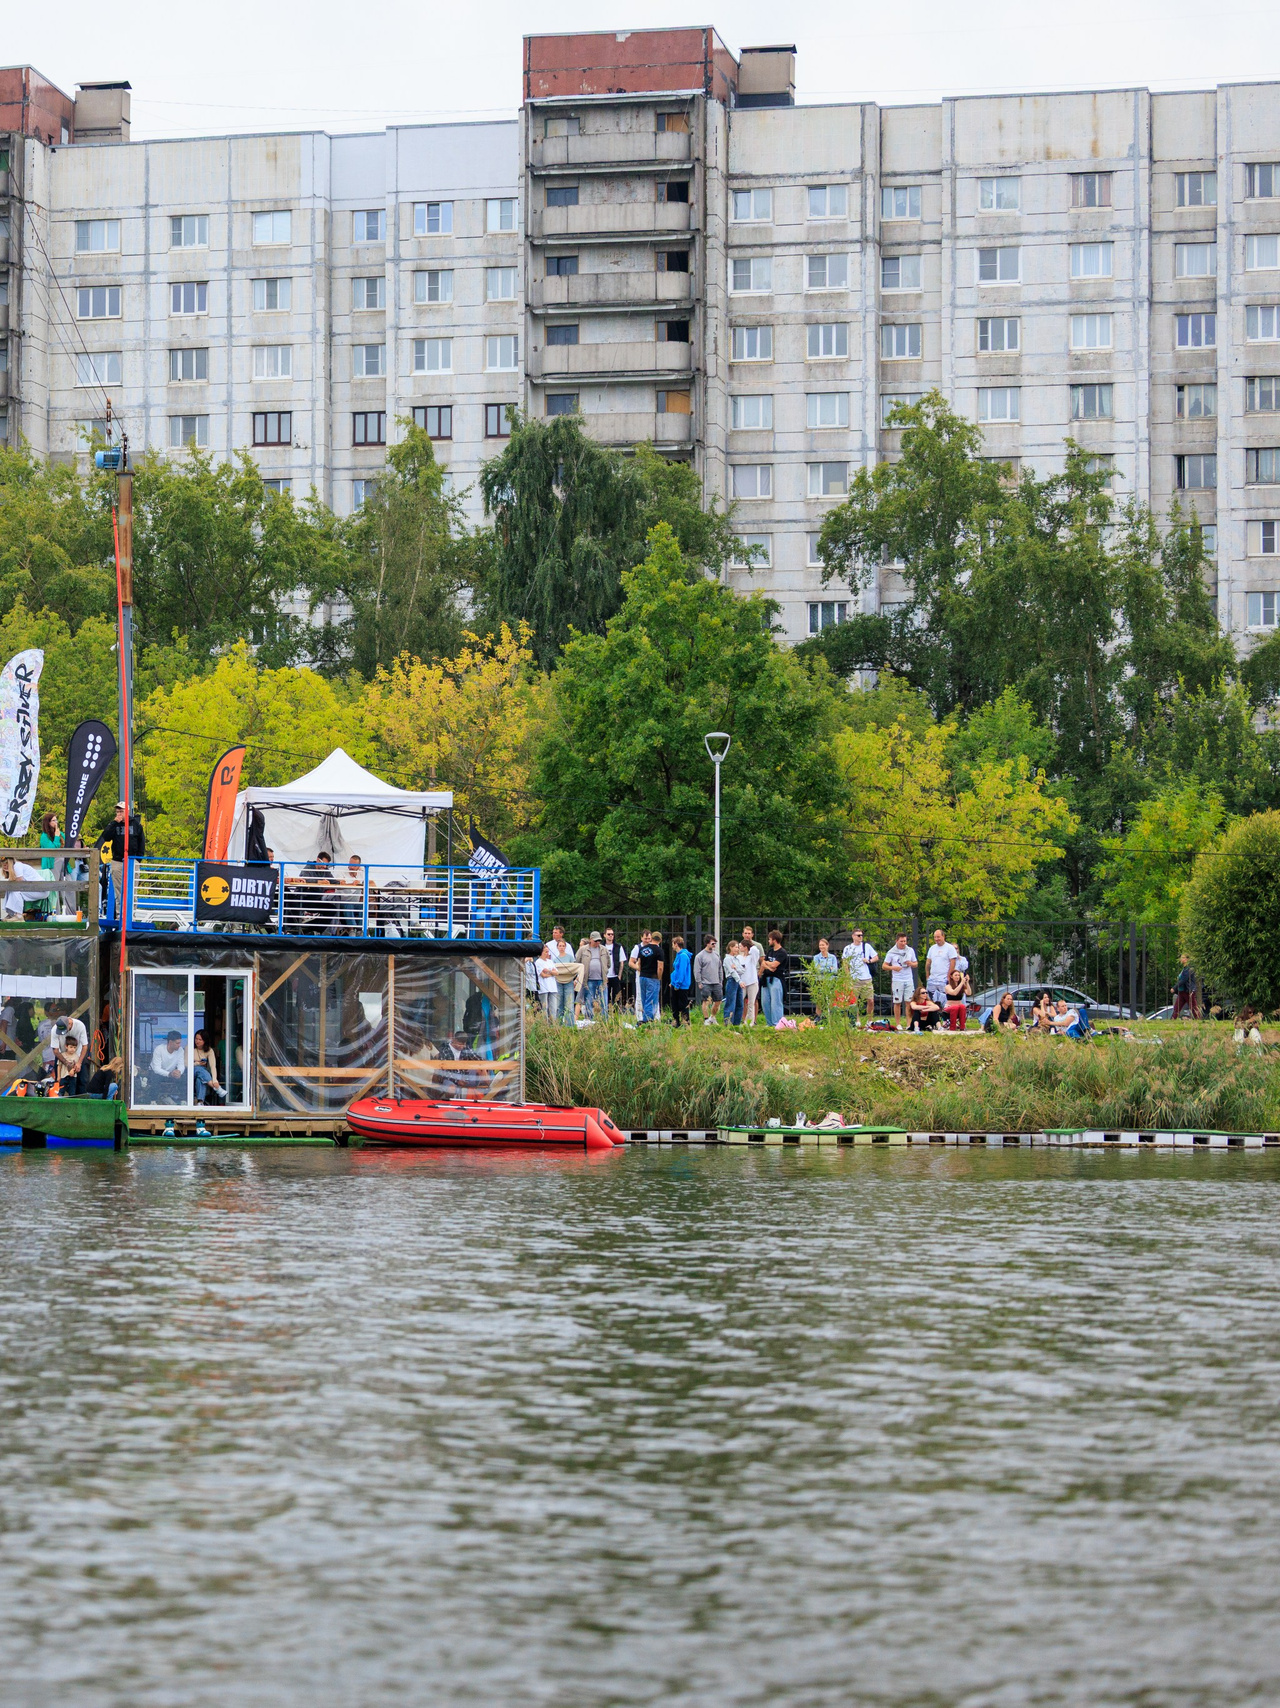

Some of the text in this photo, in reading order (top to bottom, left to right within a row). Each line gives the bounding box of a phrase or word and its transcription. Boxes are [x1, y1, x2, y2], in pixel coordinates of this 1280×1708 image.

[70, 773, 90, 838] COOL ZONE
[231, 877, 273, 896] DIRTY
[230, 894, 271, 910] HABITS
